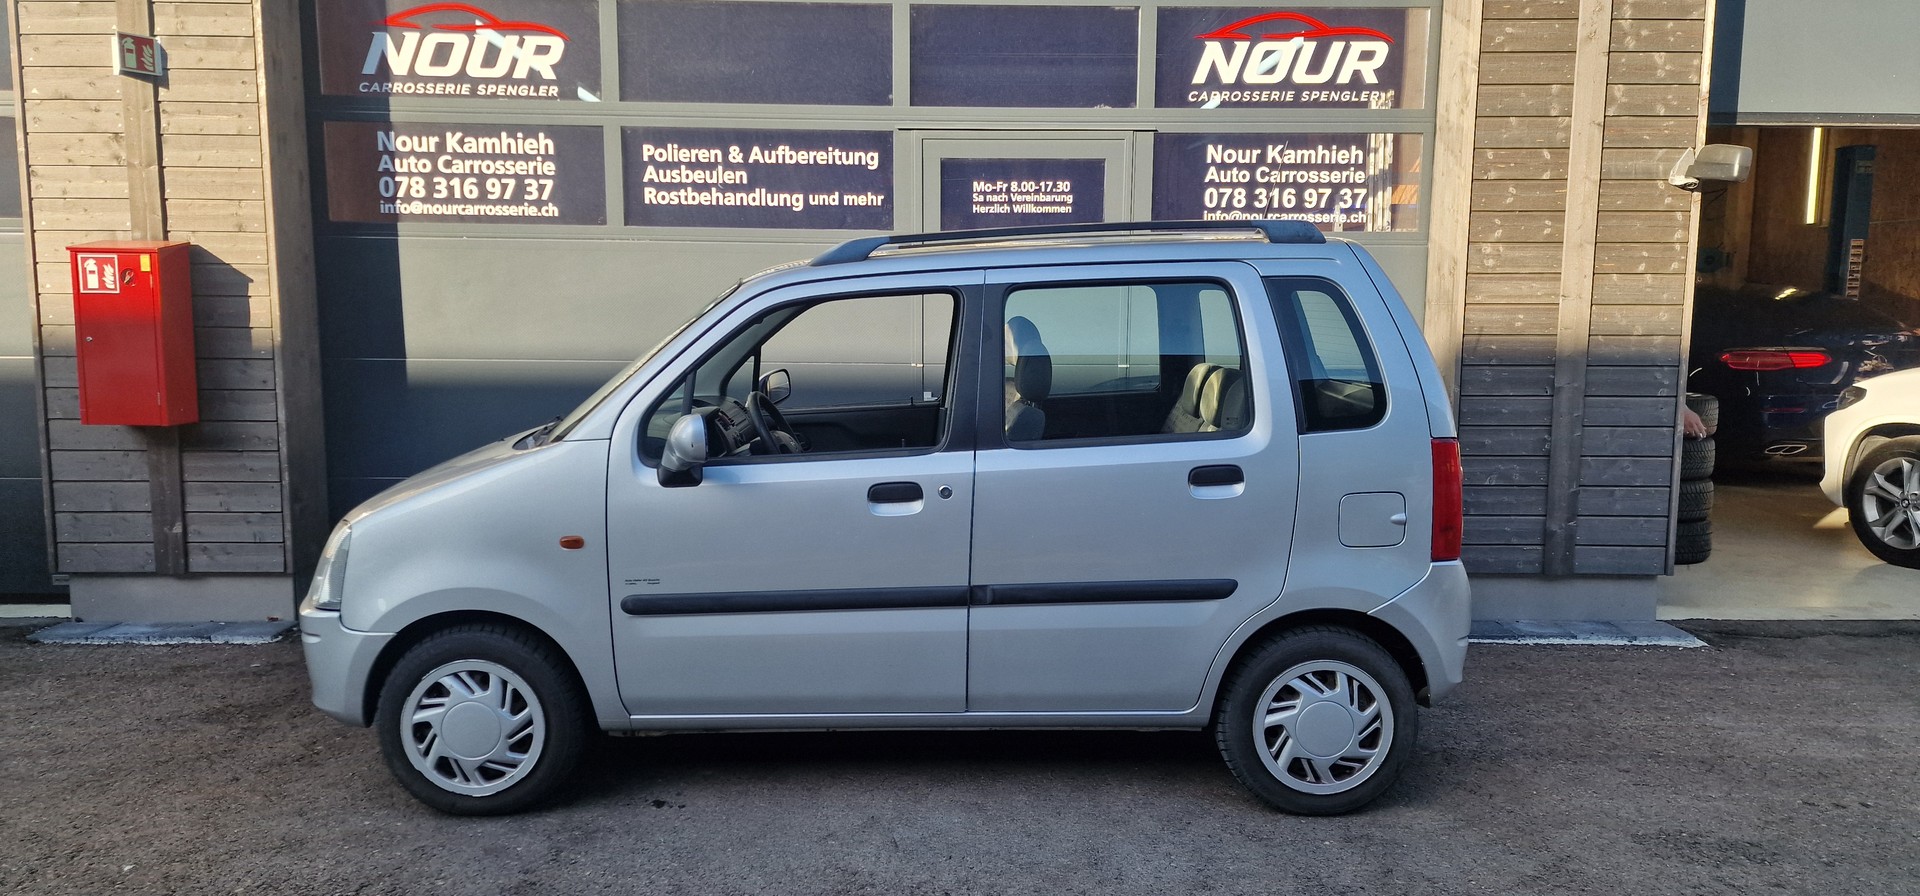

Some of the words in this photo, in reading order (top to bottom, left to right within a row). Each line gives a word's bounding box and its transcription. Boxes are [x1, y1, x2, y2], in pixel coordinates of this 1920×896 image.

[361, 32, 565, 79] NOUR
[1191, 40, 1390, 85] NOUR
[359, 81, 471, 96] CARROSSERIE
[477, 83, 559, 98] SPENGLER
[1188, 90, 1295, 103] CARROSSERIE
[1301, 90, 1380, 103] SPENGLER
[376, 131, 439, 153] Nour
[447, 132, 554, 155] Kamhieh
[642, 143, 723, 163] Polieren
[728, 145, 744, 164] &
[749, 147, 879, 170] Aufbereitung
[1206, 144, 1261, 164] Nour
[1266, 145, 1364, 165] Kamhieh
[377, 155, 432, 174] Auto
[437, 155, 555, 175] Carrosserie
[643, 165, 748, 184] Ausbeulen
[1204, 166, 1251, 184] Auto
[1255, 166, 1366, 184] Carrosserie
[378, 176, 426, 199] 078
[432, 177, 479, 200] 316
[485, 179, 516, 200] 97
[523, 178, 554, 201] 37
[972, 181, 1008, 192] Mo-Fr
[1010, 181, 1071, 192] 8.00-17.30
[380, 200, 560, 217] info@nourcarrosserie.ch
[644, 187, 803, 211] Rostbehandlung
[808, 192, 840, 206] und
[843, 192, 885, 207] mehr
[972, 193, 984, 202] Sa
[986, 193, 1008, 202] nach
[1010, 193, 1073, 204] Vereinbarung
[1204, 188, 1247, 209] 078
[1253, 188, 1296, 209] 316
[1303, 188, 1333, 209] 97
[1338, 188, 1368, 209] 37
[972, 204, 1011, 214] Herzlich
[1012, 205, 1072, 214] Willkommen
